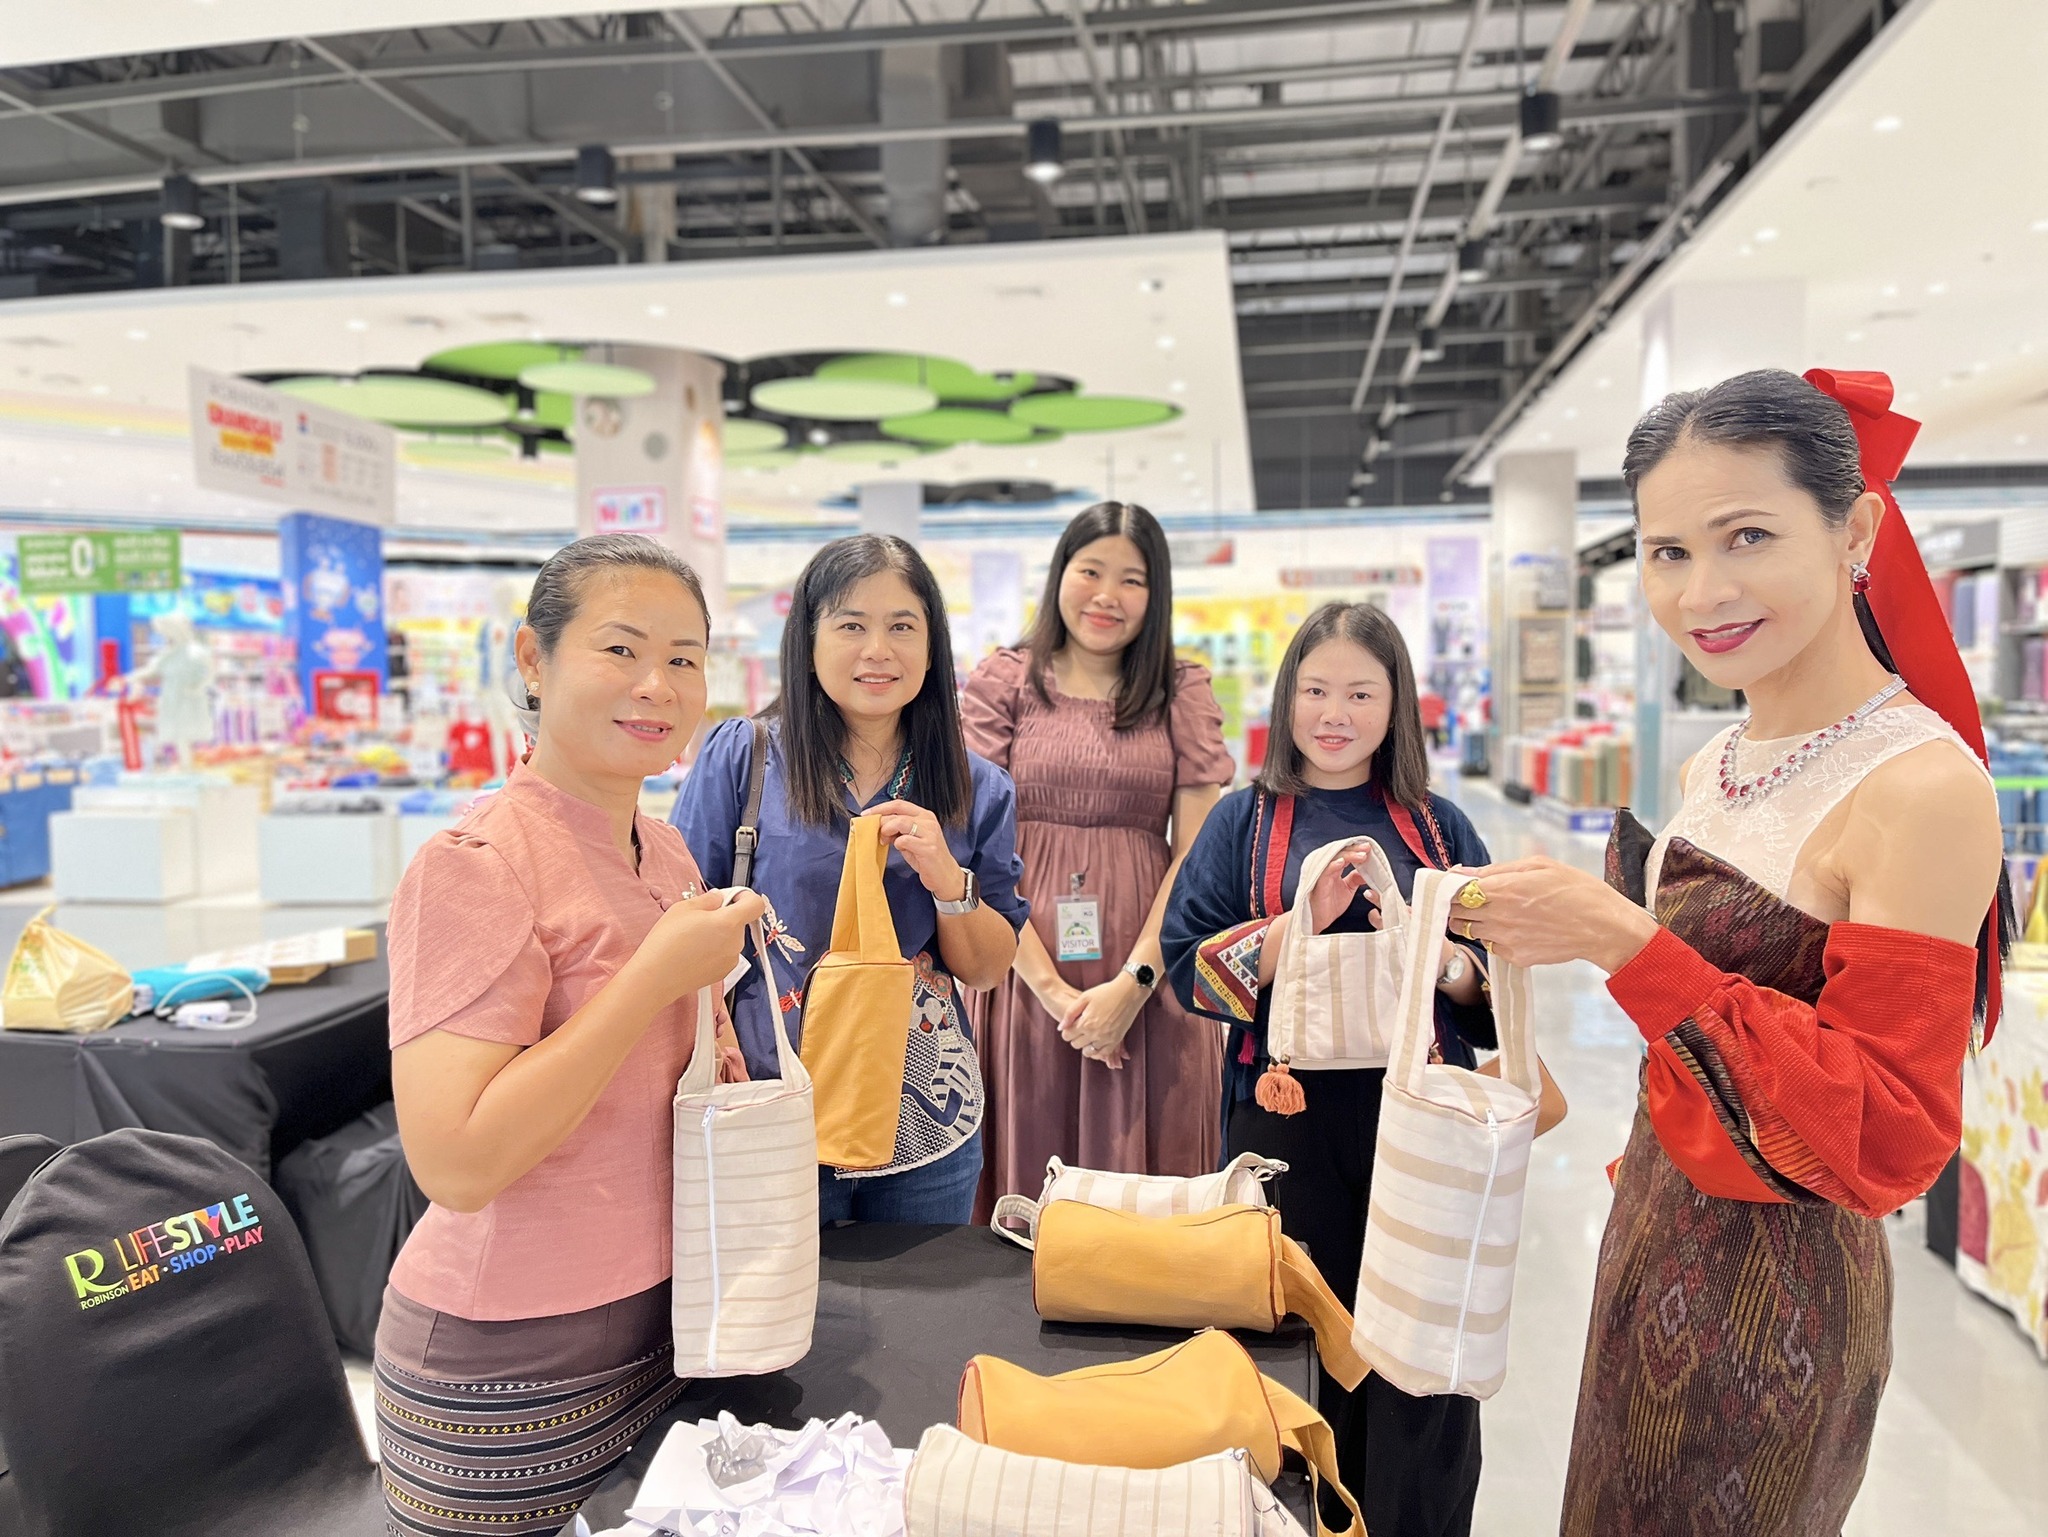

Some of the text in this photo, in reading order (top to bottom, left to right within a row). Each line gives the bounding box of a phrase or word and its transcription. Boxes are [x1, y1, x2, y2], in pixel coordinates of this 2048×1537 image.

[1061, 939, 1095, 949] VISITOR
[114, 1193, 259, 1271] LIFESTYLE
[128, 1226, 264, 1291] EAT SHOP PLAY
[80, 1285, 129, 1310] ROBINSON
